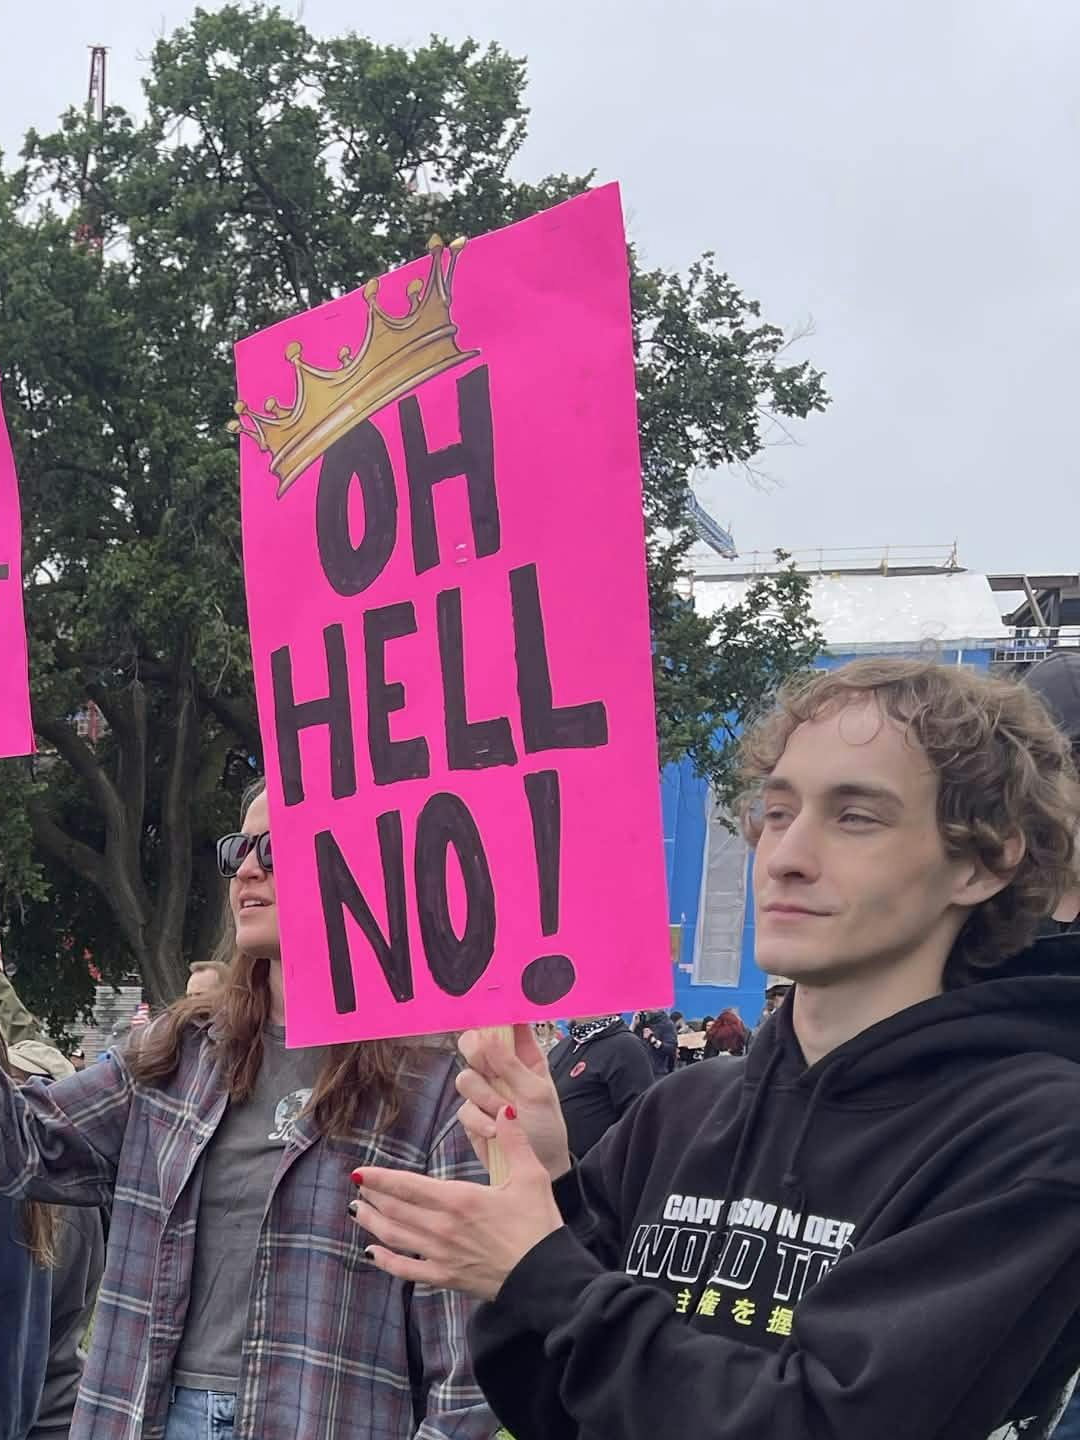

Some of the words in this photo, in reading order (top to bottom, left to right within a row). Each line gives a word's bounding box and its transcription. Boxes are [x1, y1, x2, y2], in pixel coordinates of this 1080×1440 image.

[316, 364, 502, 597] OH
[271, 563, 609, 806] HELL
[314, 769, 576, 1014] NO!
[625, 1223, 767, 1291] WOD
[776, 1207, 802, 1239] IN
